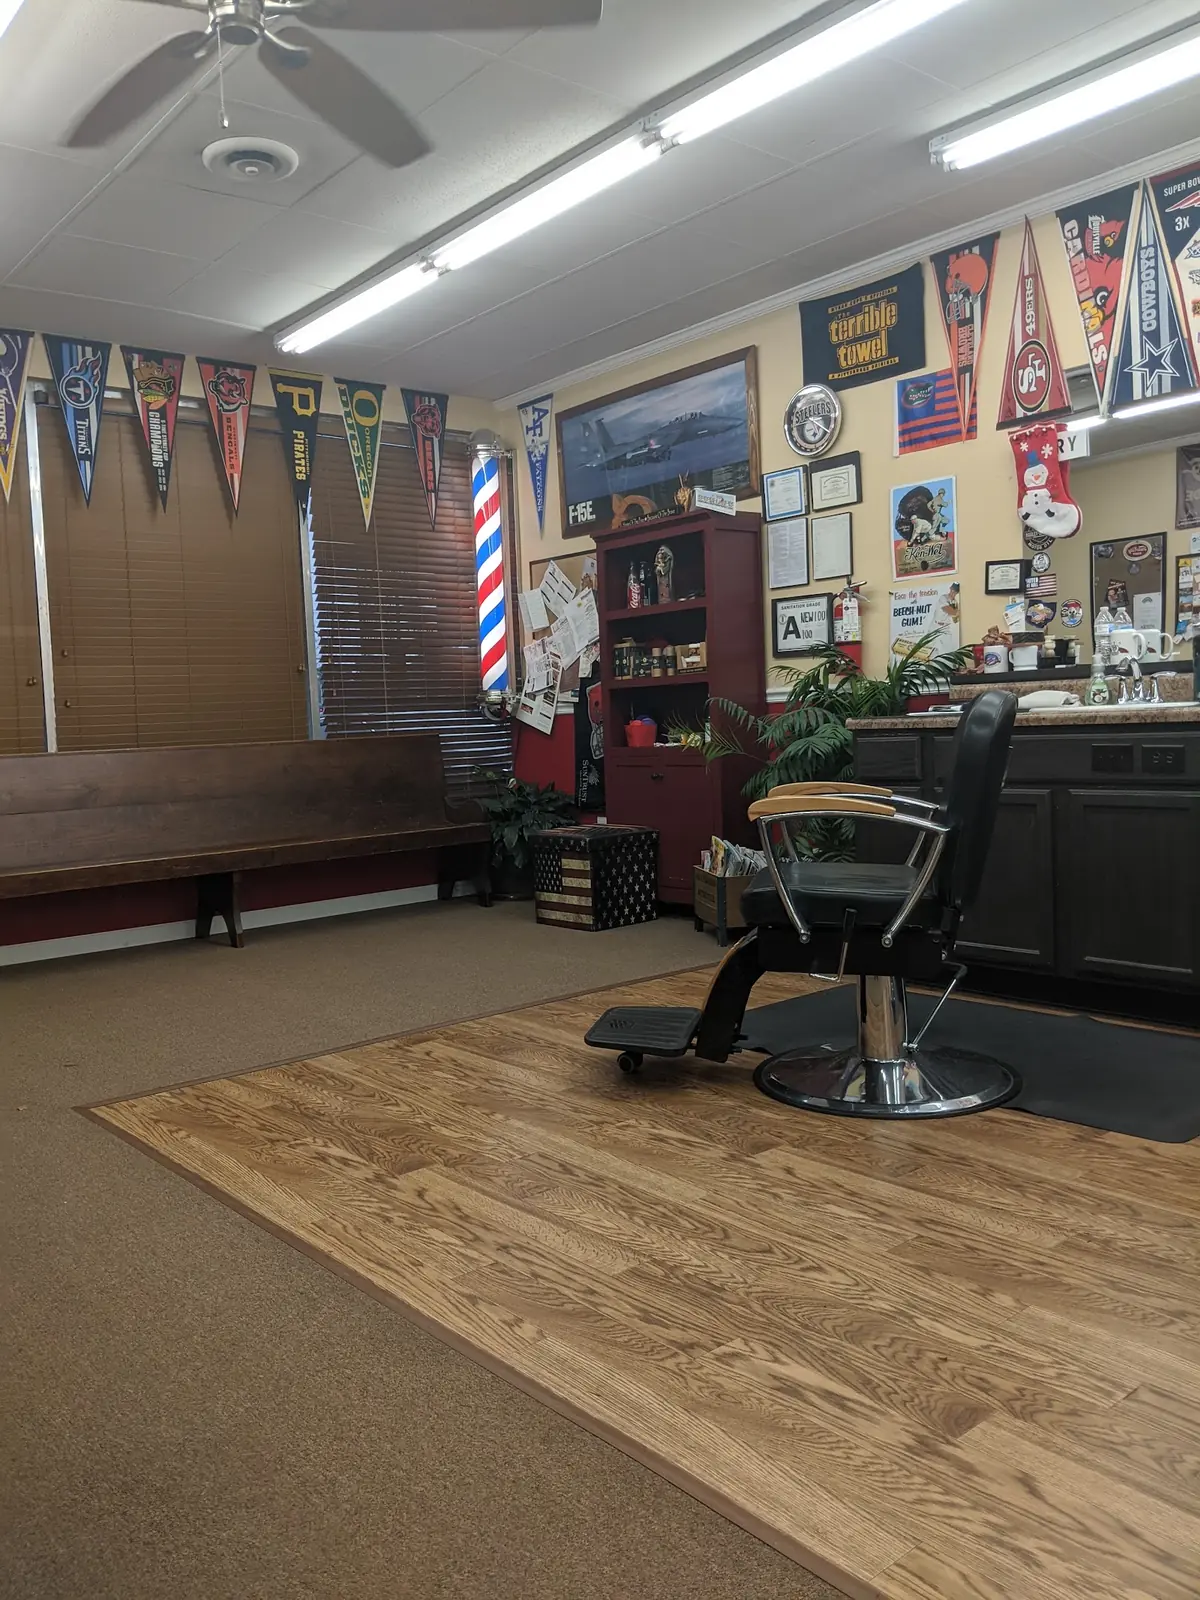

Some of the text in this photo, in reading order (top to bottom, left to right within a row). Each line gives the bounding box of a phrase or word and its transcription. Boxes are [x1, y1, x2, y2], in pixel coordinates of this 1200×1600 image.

[1163, 180, 1186, 197] SUPER
[1088, 214, 1105, 255] LOUISVILLE
[1175, 216, 1190, 231] 3X
[1025, 277, 1036, 337] 49ERS
[1063, 219, 1108, 367] CARDINALS
[1140, 246, 1157, 333] COWBOYS
[829, 300, 897, 343] terrible
[837, 328, 888, 369] towel
[958, 326, 968, 368] BROWNS
[1018, 353, 1046, 394] SF
[277, 383, 316, 417] P
[352, 389, 379, 427] O
[526, 401, 549, 437] AF
[795, 401, 831, 424] STEELERS
[76, 418, 91, 455] TITANS
[149, 411, 164, 468] CHAMPIONS
[226, 417, 235, 470] BENGALS
[292, 430, 306, 481] PIRATES
[338, 384, 370, 499] DUCKS
[364, 427, 372, 478] OREGON
[424, 440, 435, 490] BEARS
[905, 543, 943, 560] Ken-Wel
[893, 603, 932, 617] BEECH-NUT
[894, 589, 938, 600] Ease the tension
[782, 616, 801, 640] A
[802, 630, 813, 640] 100
[901, 616, 922, 627] GUM!
